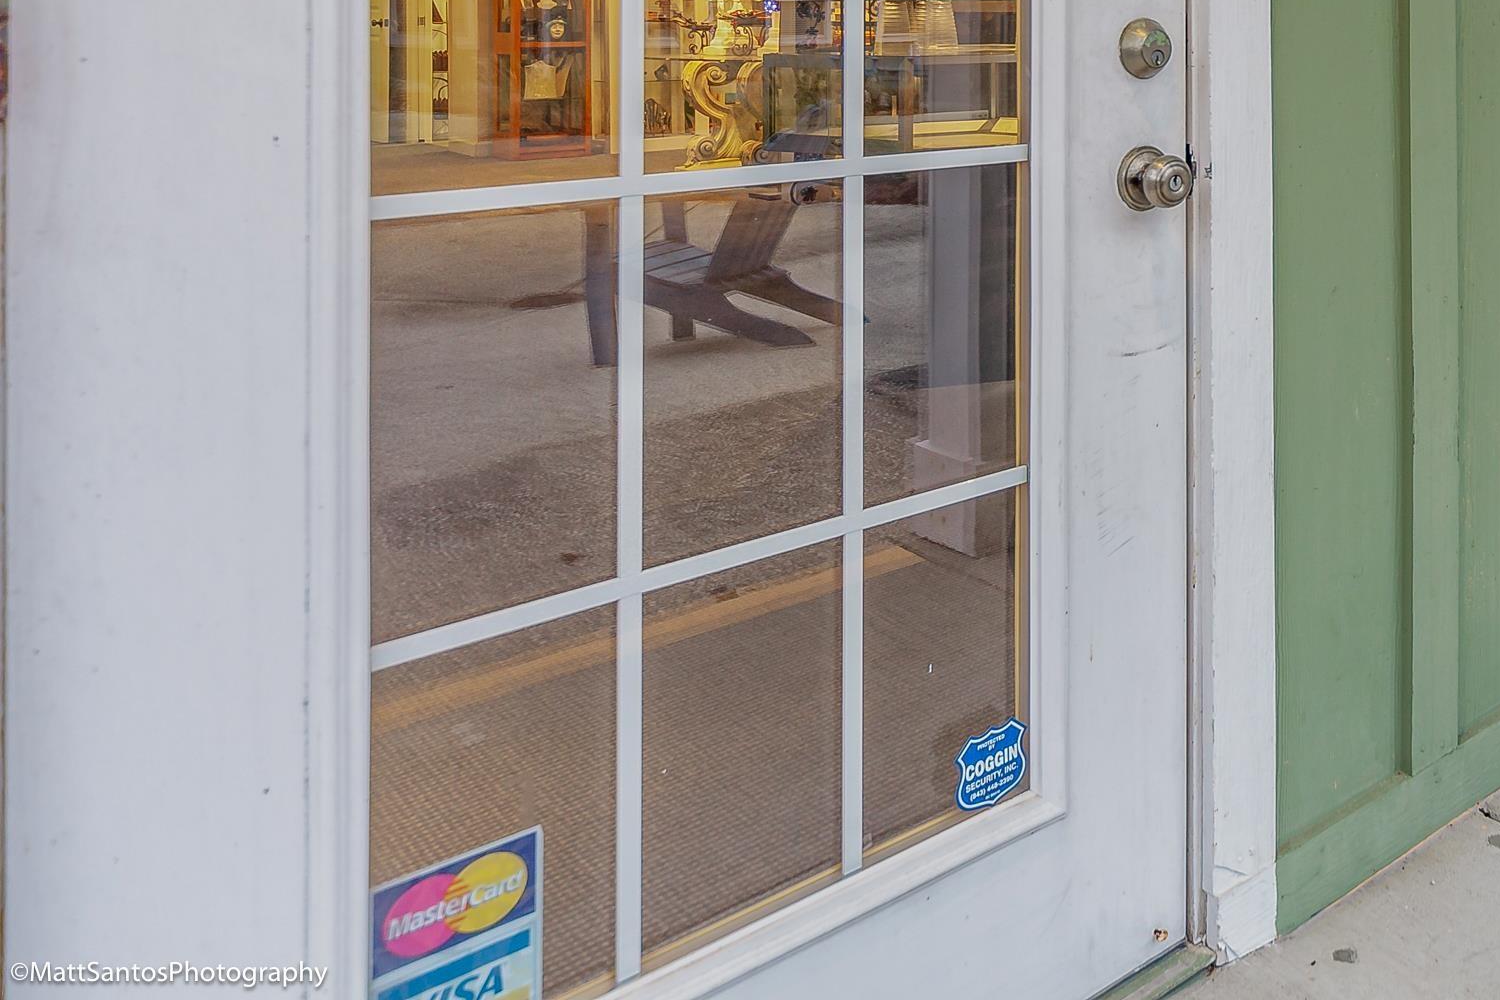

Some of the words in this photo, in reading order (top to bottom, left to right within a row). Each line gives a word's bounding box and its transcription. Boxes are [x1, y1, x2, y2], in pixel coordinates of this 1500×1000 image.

[965, 768, 1003, 794] SECURITY,
[1004, 762, 1019, 775] INC.
[966, 743, 1018, 782] COGGIN
[386, 868, 524, 942] MasterCard
